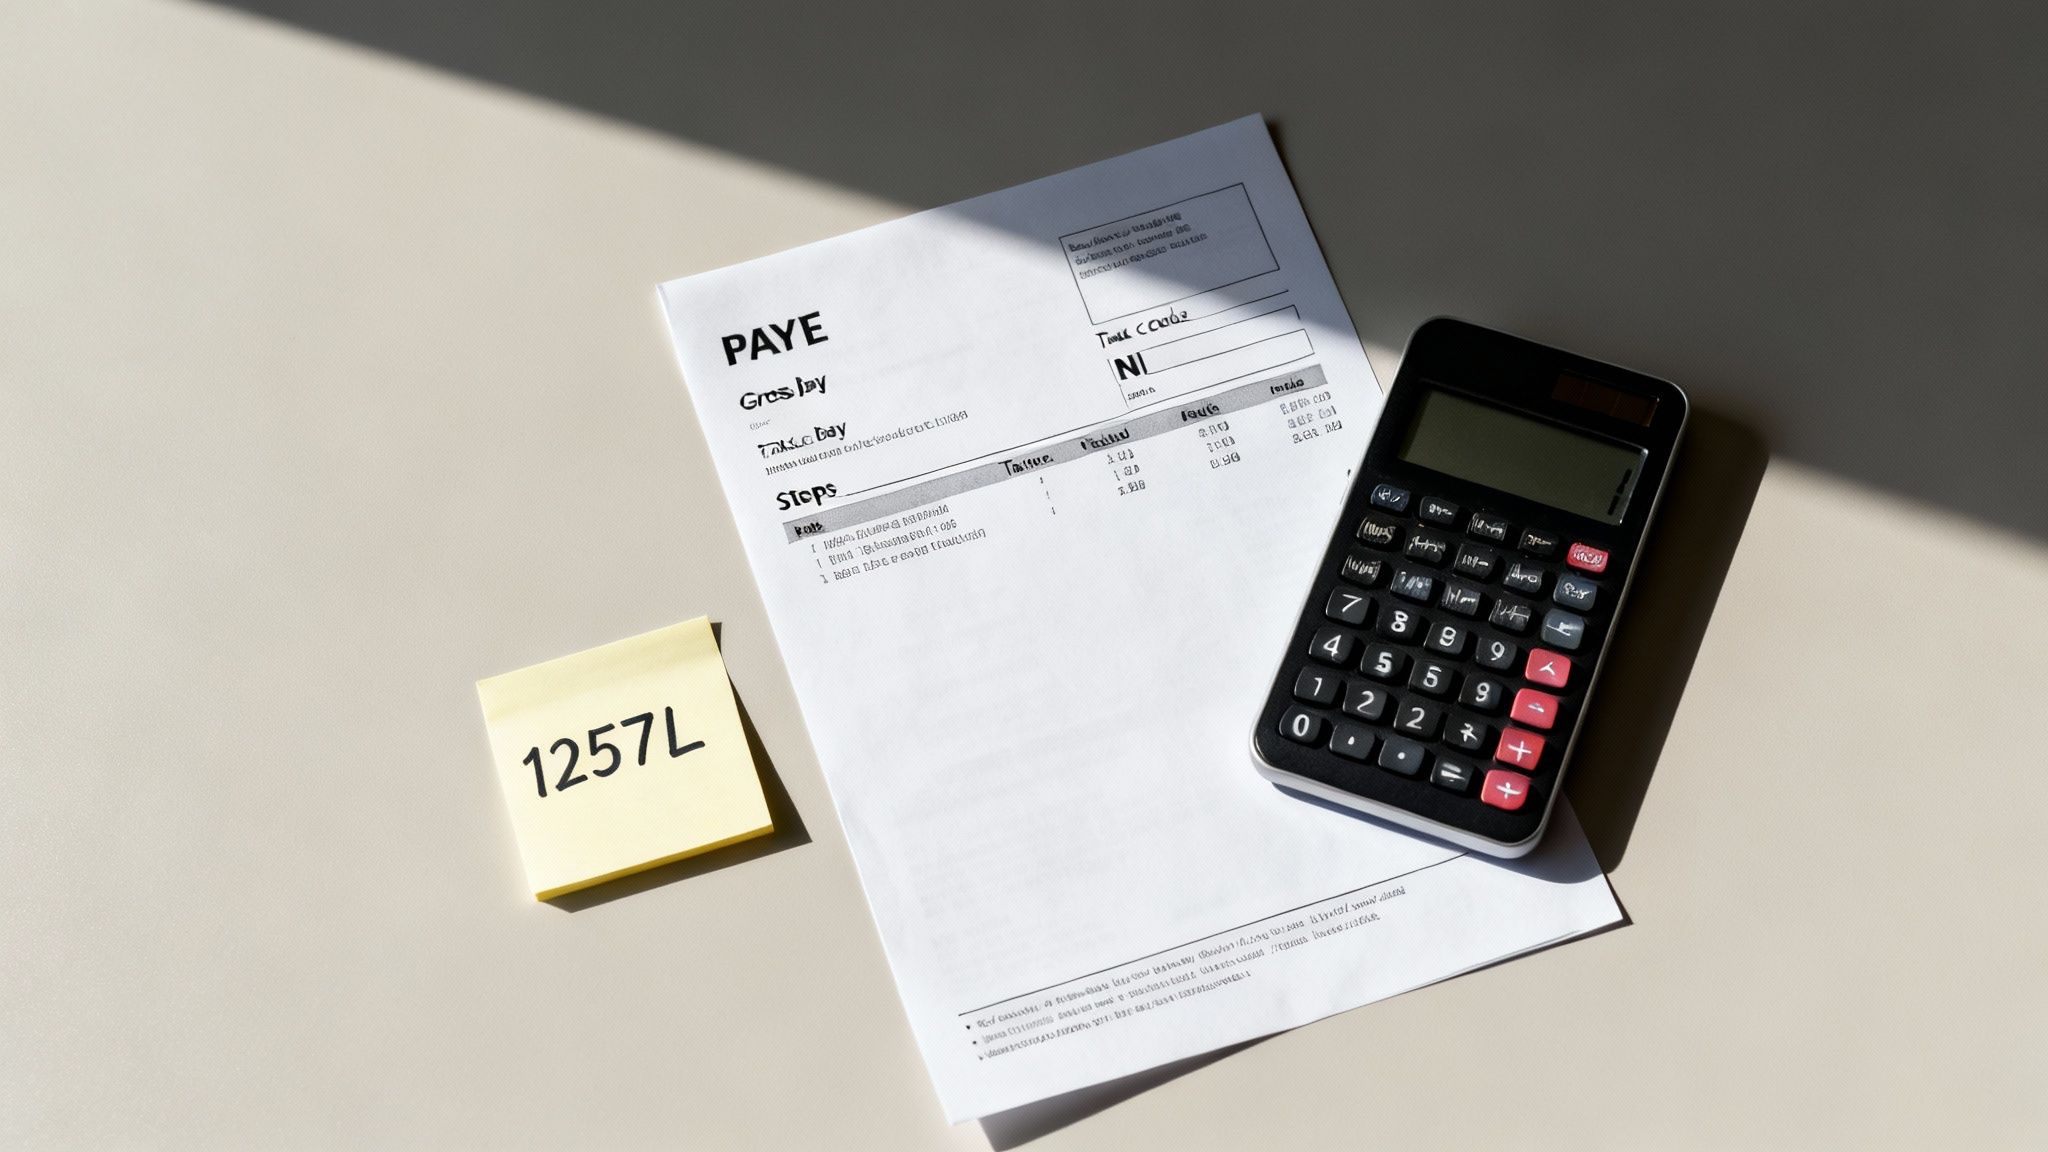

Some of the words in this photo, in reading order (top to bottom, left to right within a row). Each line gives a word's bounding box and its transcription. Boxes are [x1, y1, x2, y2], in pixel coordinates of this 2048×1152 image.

[722, 311, 829, 366] PAYE
[776, 483, 838, 511] Stops
[1323, 634, 1343, 660] 4
[1375, 651, 1393, 674] 5
[1342, 593, 1363, 613] 7
[1391, 610, 1409, 633] 8
[1491, 641, 1506, 661] 9
[1292, 714, 1310, 737] 0
[1313, 676, 1323, 696] 1
[1356, 690, 1375, 711] 2
[1406, 707, 1426, 730] 2
[522, 706, 706, 798] 1257L
